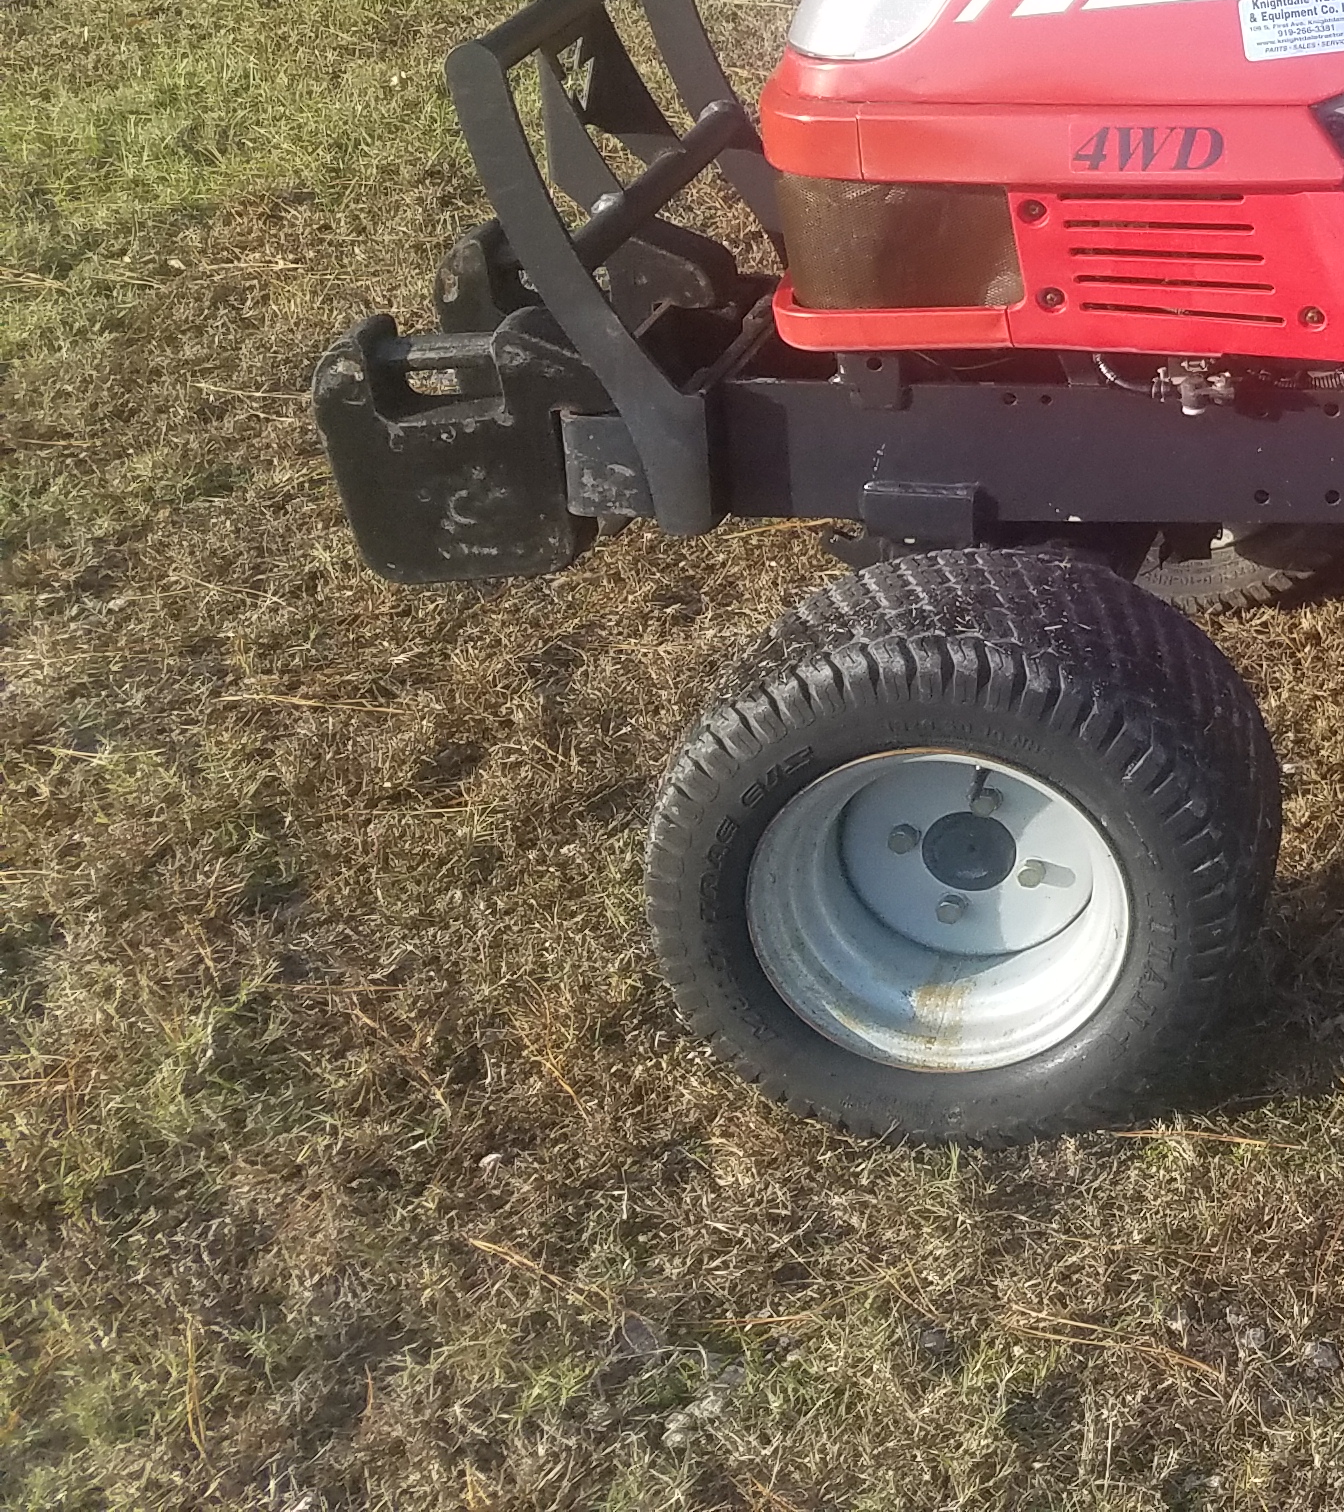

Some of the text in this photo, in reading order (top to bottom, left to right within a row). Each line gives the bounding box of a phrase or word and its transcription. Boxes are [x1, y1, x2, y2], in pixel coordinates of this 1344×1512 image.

[1249, 12, 1258, 23] &
[1261, 6, 1318, 22] Equipment
[1321, 4, 1339, 15] Co.
[1292, 42, 1316, 51] SALES
[1072, 126, 1225, 172] 4WD
